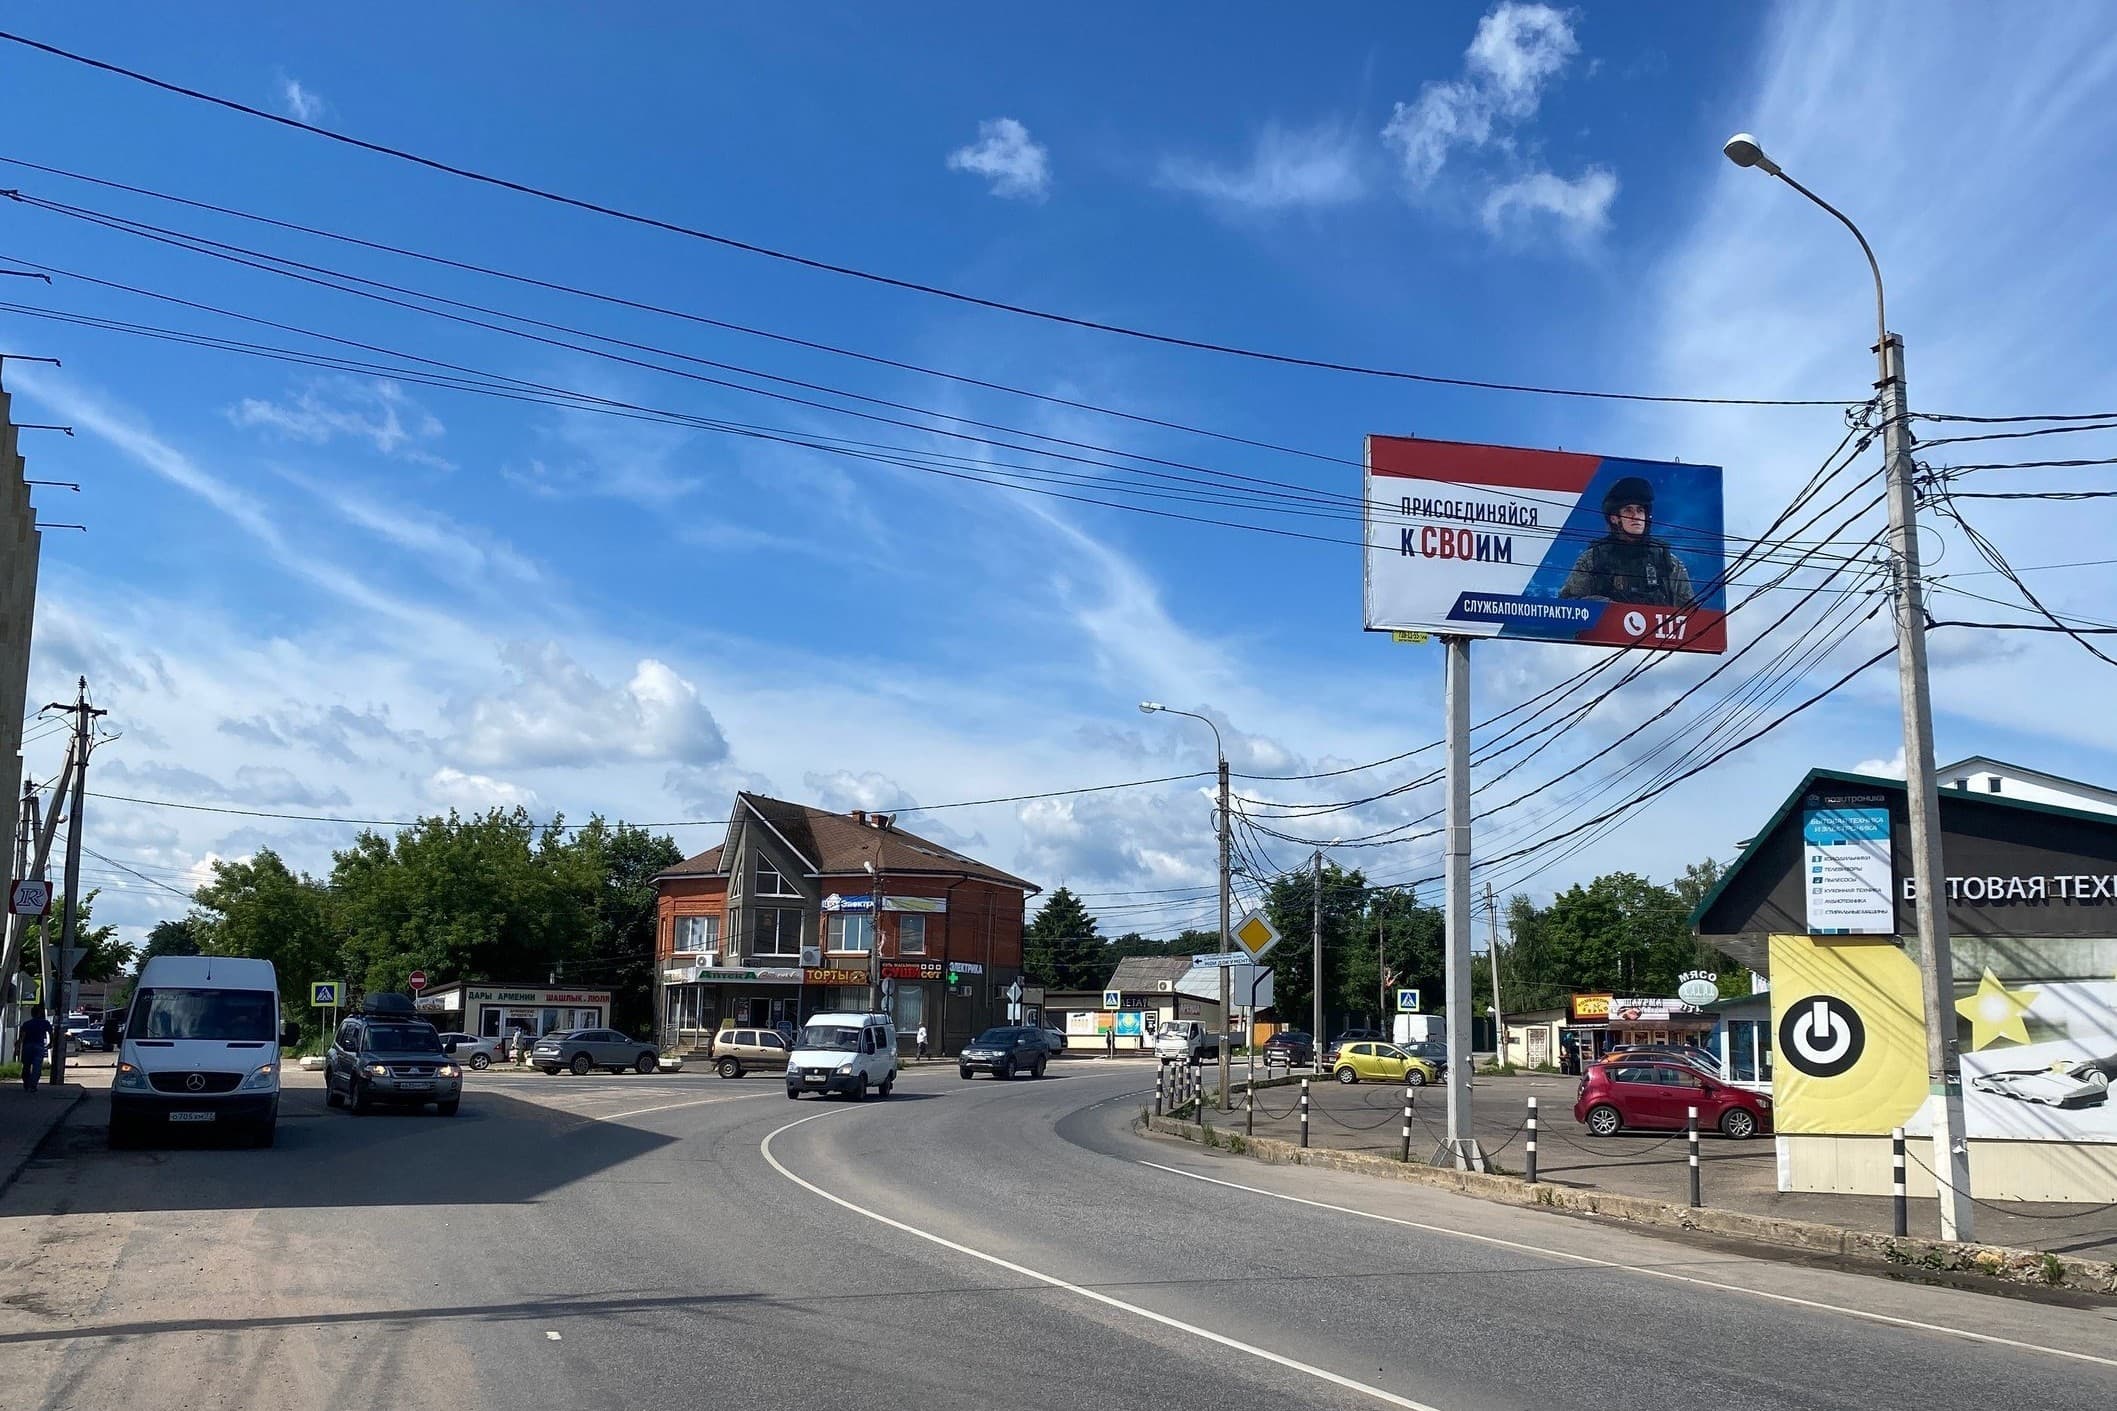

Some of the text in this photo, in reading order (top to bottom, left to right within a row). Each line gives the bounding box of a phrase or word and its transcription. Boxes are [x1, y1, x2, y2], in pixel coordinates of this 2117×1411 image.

[1401, 497, 1538, 526] ПРИСОЕДИНЯЙСЯ
[1401, 526, 1512, 563] К СВОИМ
[1463, 600, 1590, 621] СЛУЖБАПОКОНТРАКТУ.РФ
[1655, 613, 1688, 640] 117
[1903, 876, 2045, 899] БТОВАЯ
[807, 970, 849, 980] ТОРТЫ
[882, 967, 920, 977] СУШИ
[1678, 970, 1717, 983] МЯСО
[468, 992, 492, 1000] ДАРЫ
[498, 993, 536, 1001] АРМЕНИИ
